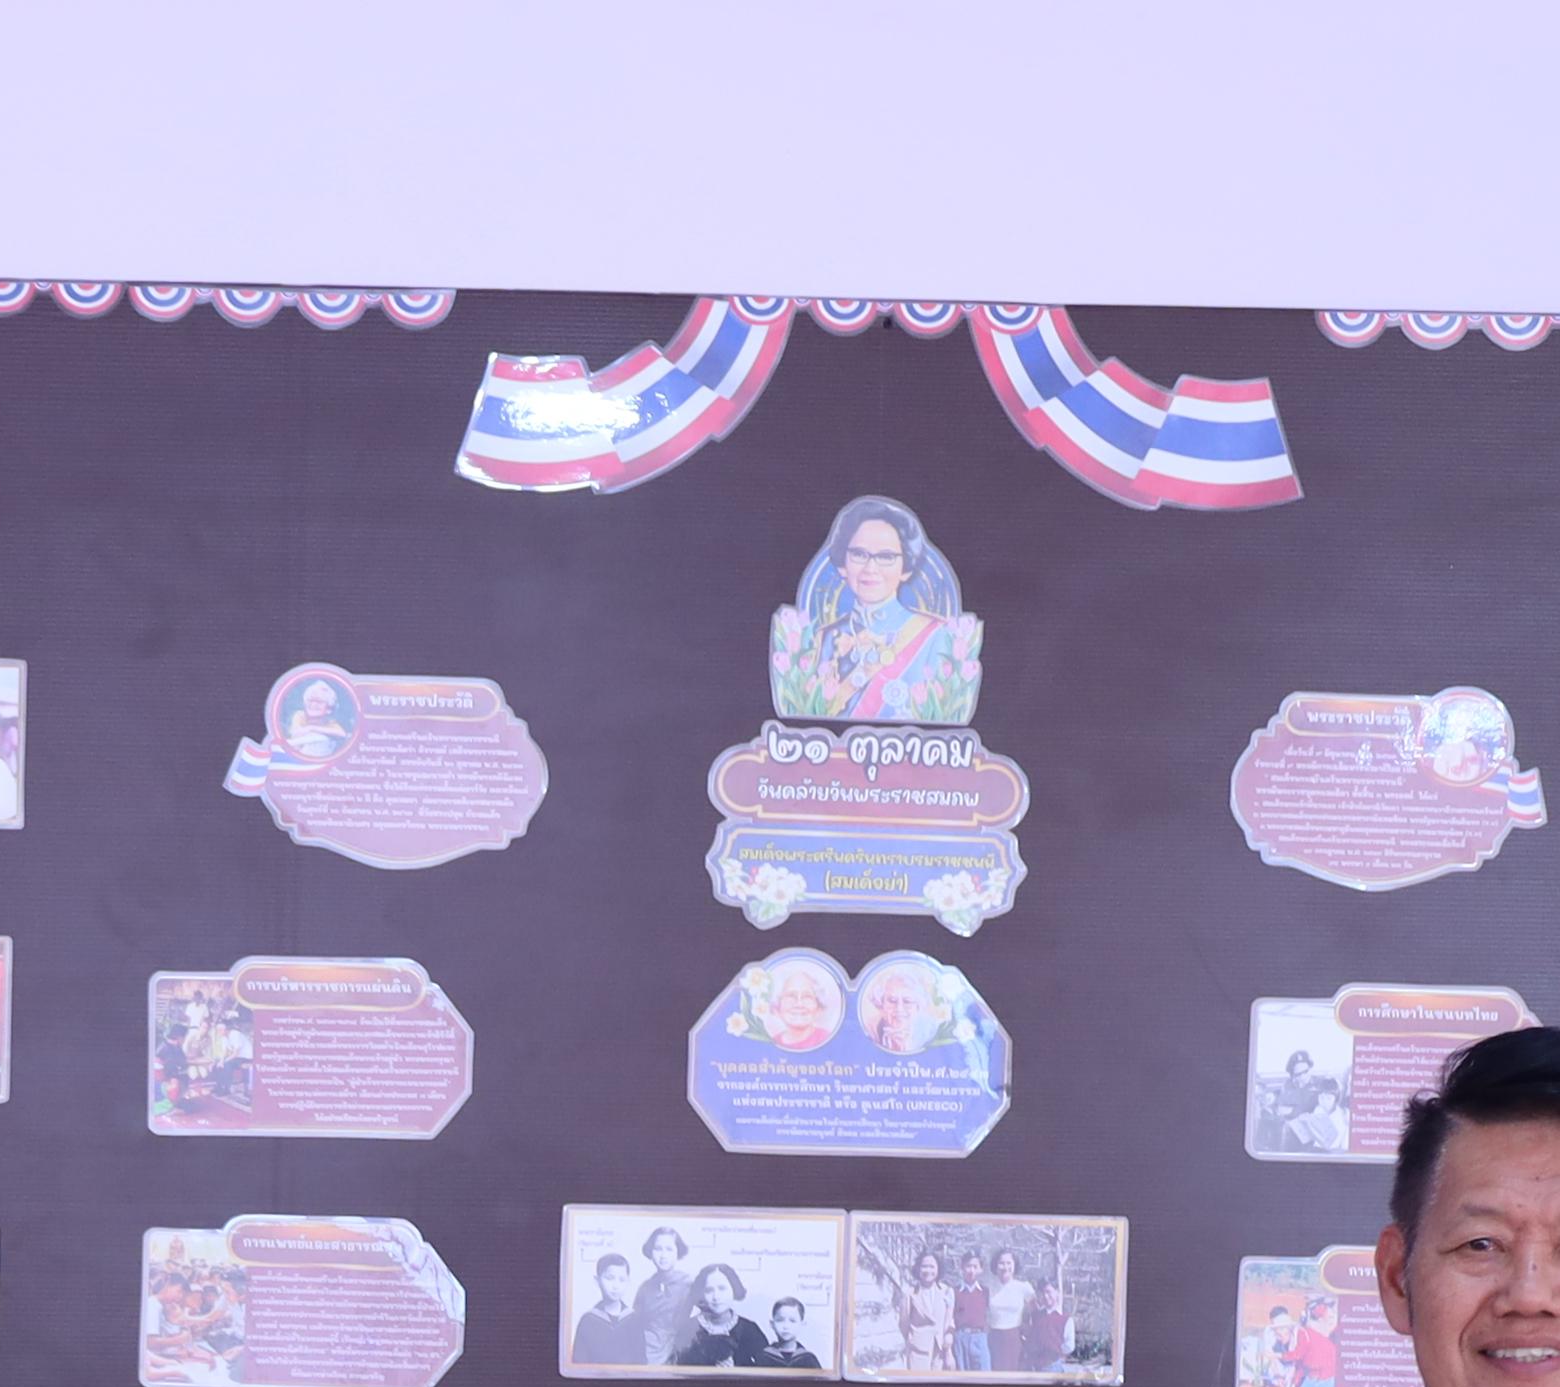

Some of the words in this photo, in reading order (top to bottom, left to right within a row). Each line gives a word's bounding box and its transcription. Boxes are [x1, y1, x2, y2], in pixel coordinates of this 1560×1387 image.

[369, 690, 475, 711] พระราชประวัติ
[767, 730, 830, 764] ๒๑
[849, 735, 974, 782] ตุลาคม
[758, 778, 980, 808] วันคล้ายวันพระราชสมภพ
[824, 870, 909, 894] (สมเด็จย่า)
[245, 976, 412, 995] การบริหารราชการแผ่นดิน
[1358, 1003, 1499, 1022] การศึกษาในชนบทไทย
[906, 1100, 964, 1114] (UNESCO)
